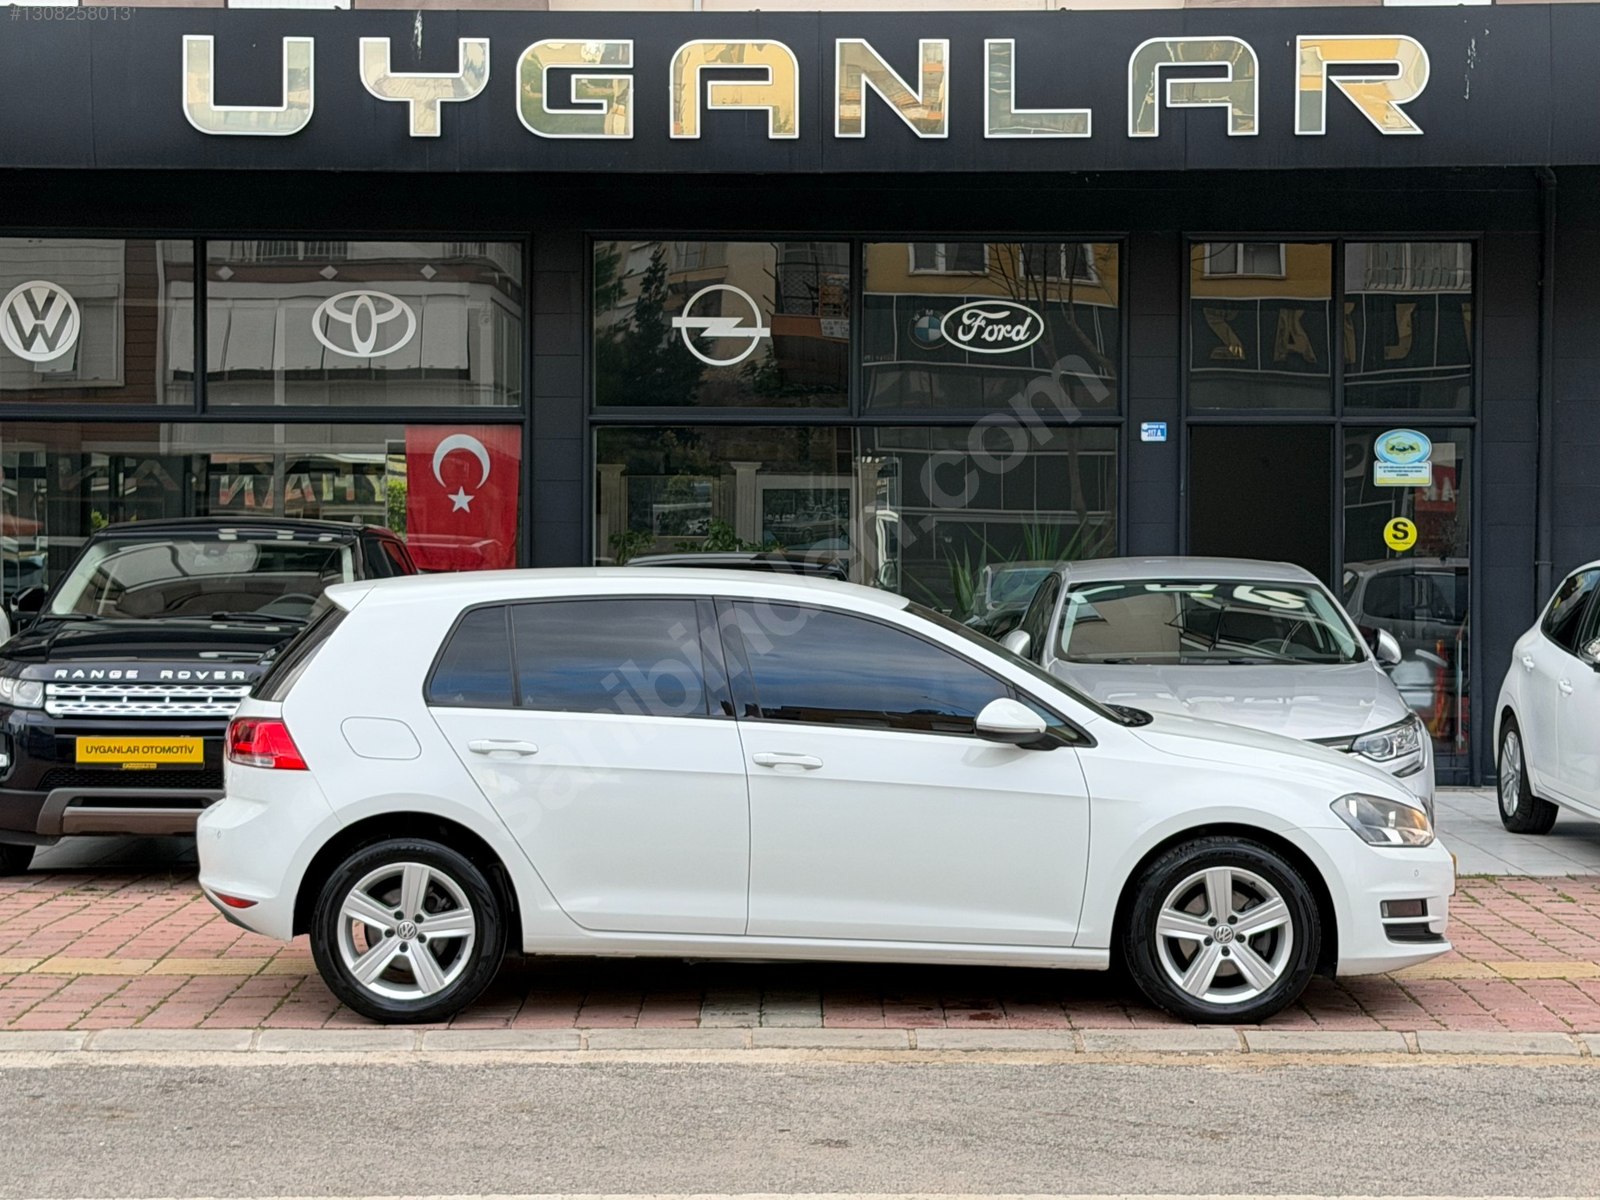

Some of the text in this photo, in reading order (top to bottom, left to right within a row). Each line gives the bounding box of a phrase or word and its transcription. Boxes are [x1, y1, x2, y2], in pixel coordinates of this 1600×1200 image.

[181, 34, 1431, 140] UYGANLAR
[958, 308, 1033, 342] Ford
[1391, 521, 1409, 541] S
[54, 669, 246, 680] RANGE ROVER
[85, 744, 195, 754] UYGANLAR OTOMOTİV
